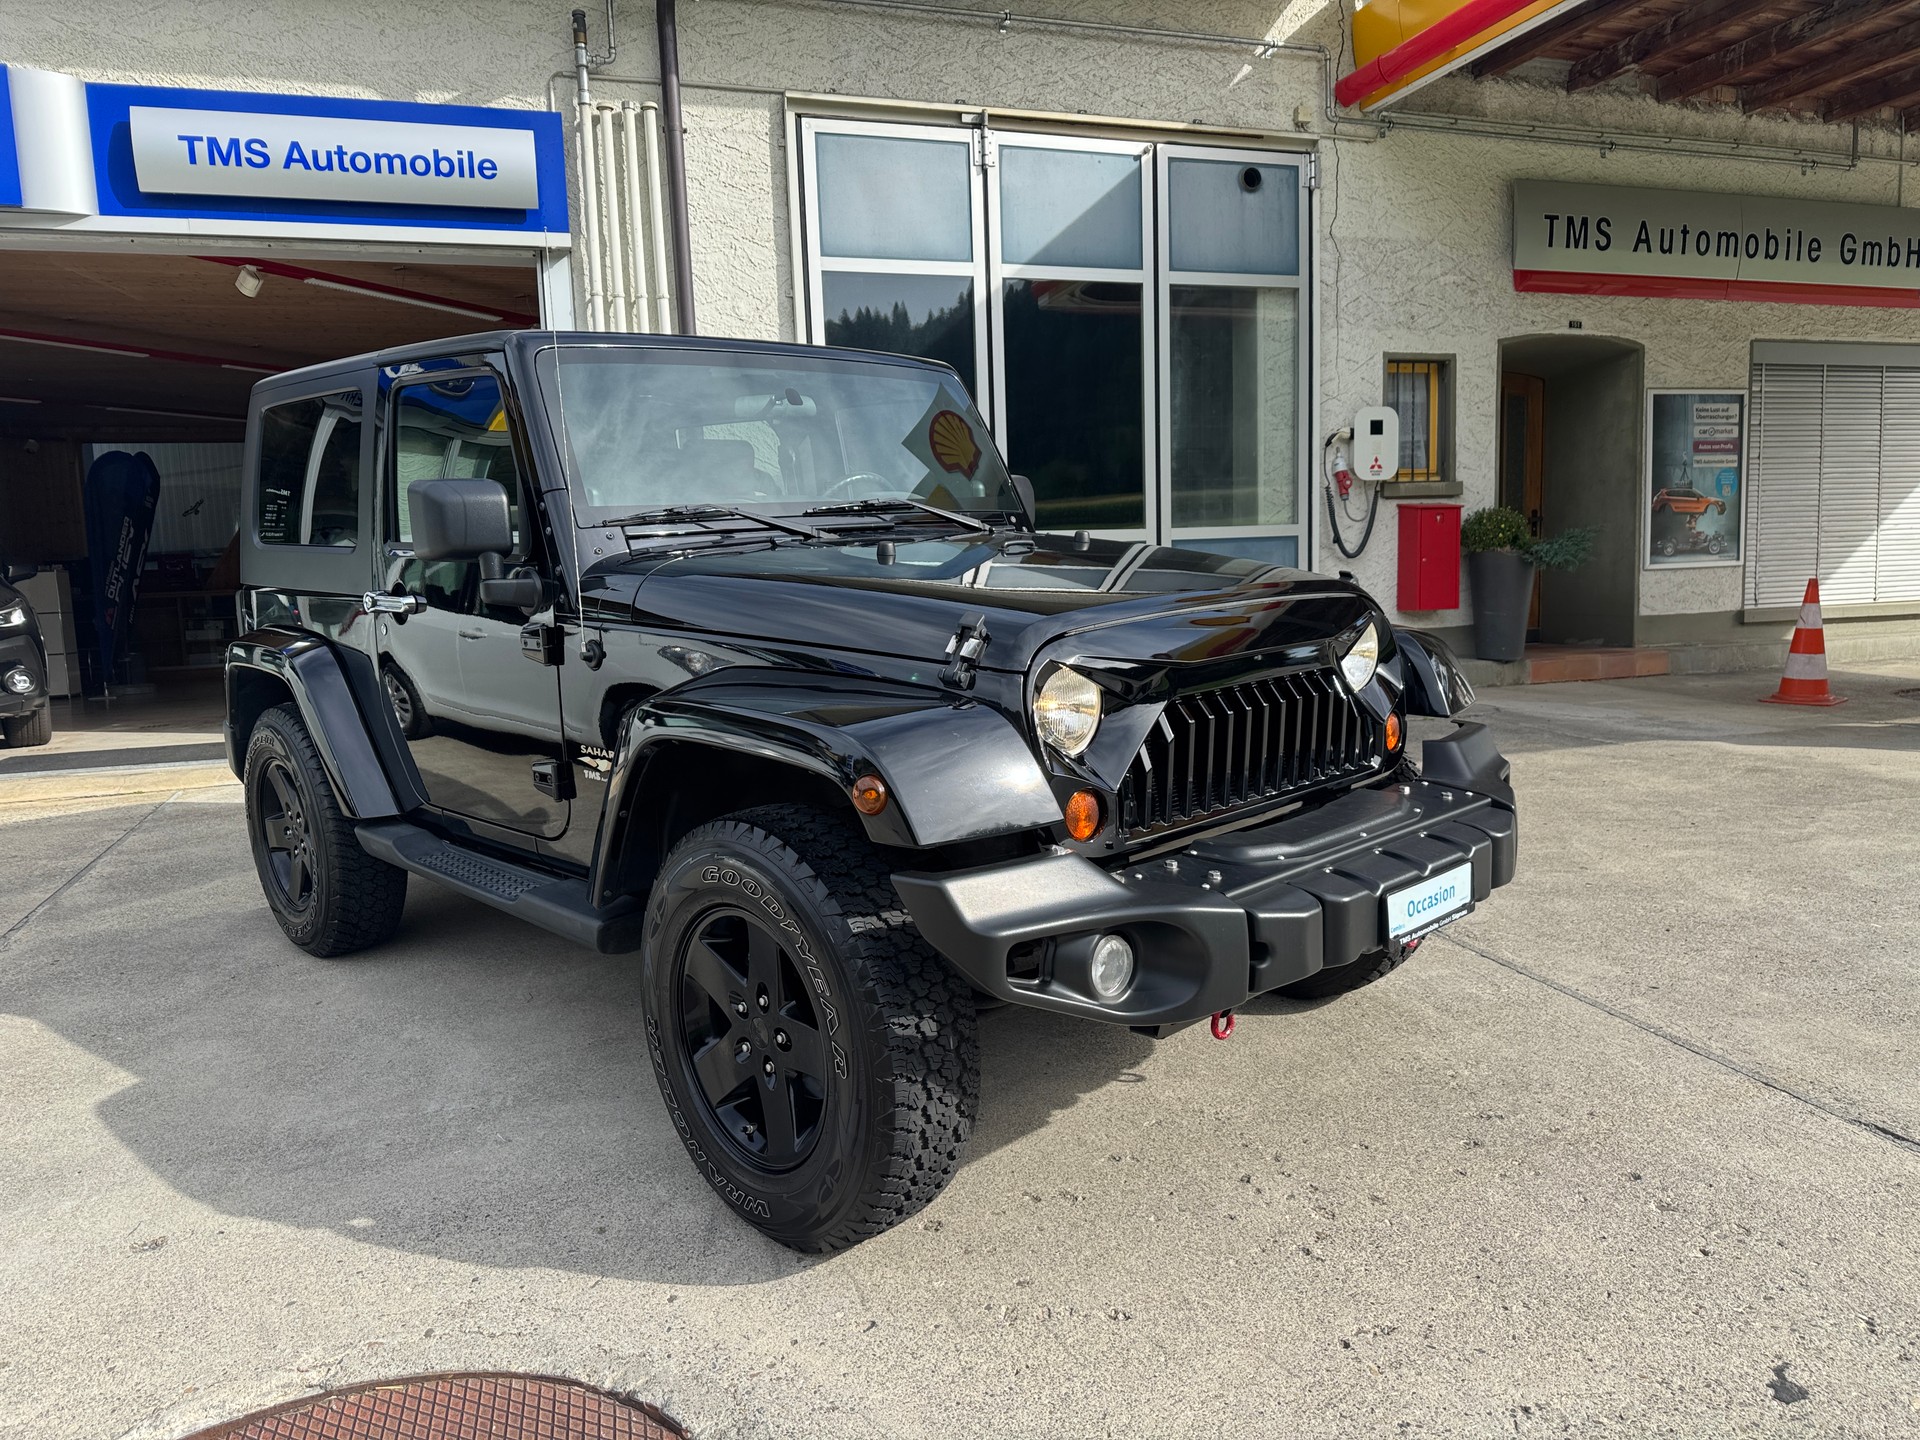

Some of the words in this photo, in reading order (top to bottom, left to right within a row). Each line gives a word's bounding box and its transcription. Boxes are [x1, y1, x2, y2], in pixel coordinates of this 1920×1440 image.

[177, 135, 271, 169] TMS
[283, 141, 498, 180] Automobile
[1544, 214, 1612, 251] TMS
[1632, 220, 1822, 263] Automobile
[1840, 232, 1920, 268] GmbH
[1695, 413, 1738, 421] Überraschungen?
[107, 516, 130, 599] OUTLANDER
[580, 744, 615, 759] SAHAR
[583, 769, 601, 781] TMS
[1407, 884, 1455, 918] Occasion
[1400, 934, 1411, 945] TMS
[1411, 922, 1439, 939] Automobile
[1439, 916, 1452, 926] GmbH
[700, 864, 848, 1080] GOODYEAR
[646, 1014, 772, 1219] WRANGLER
